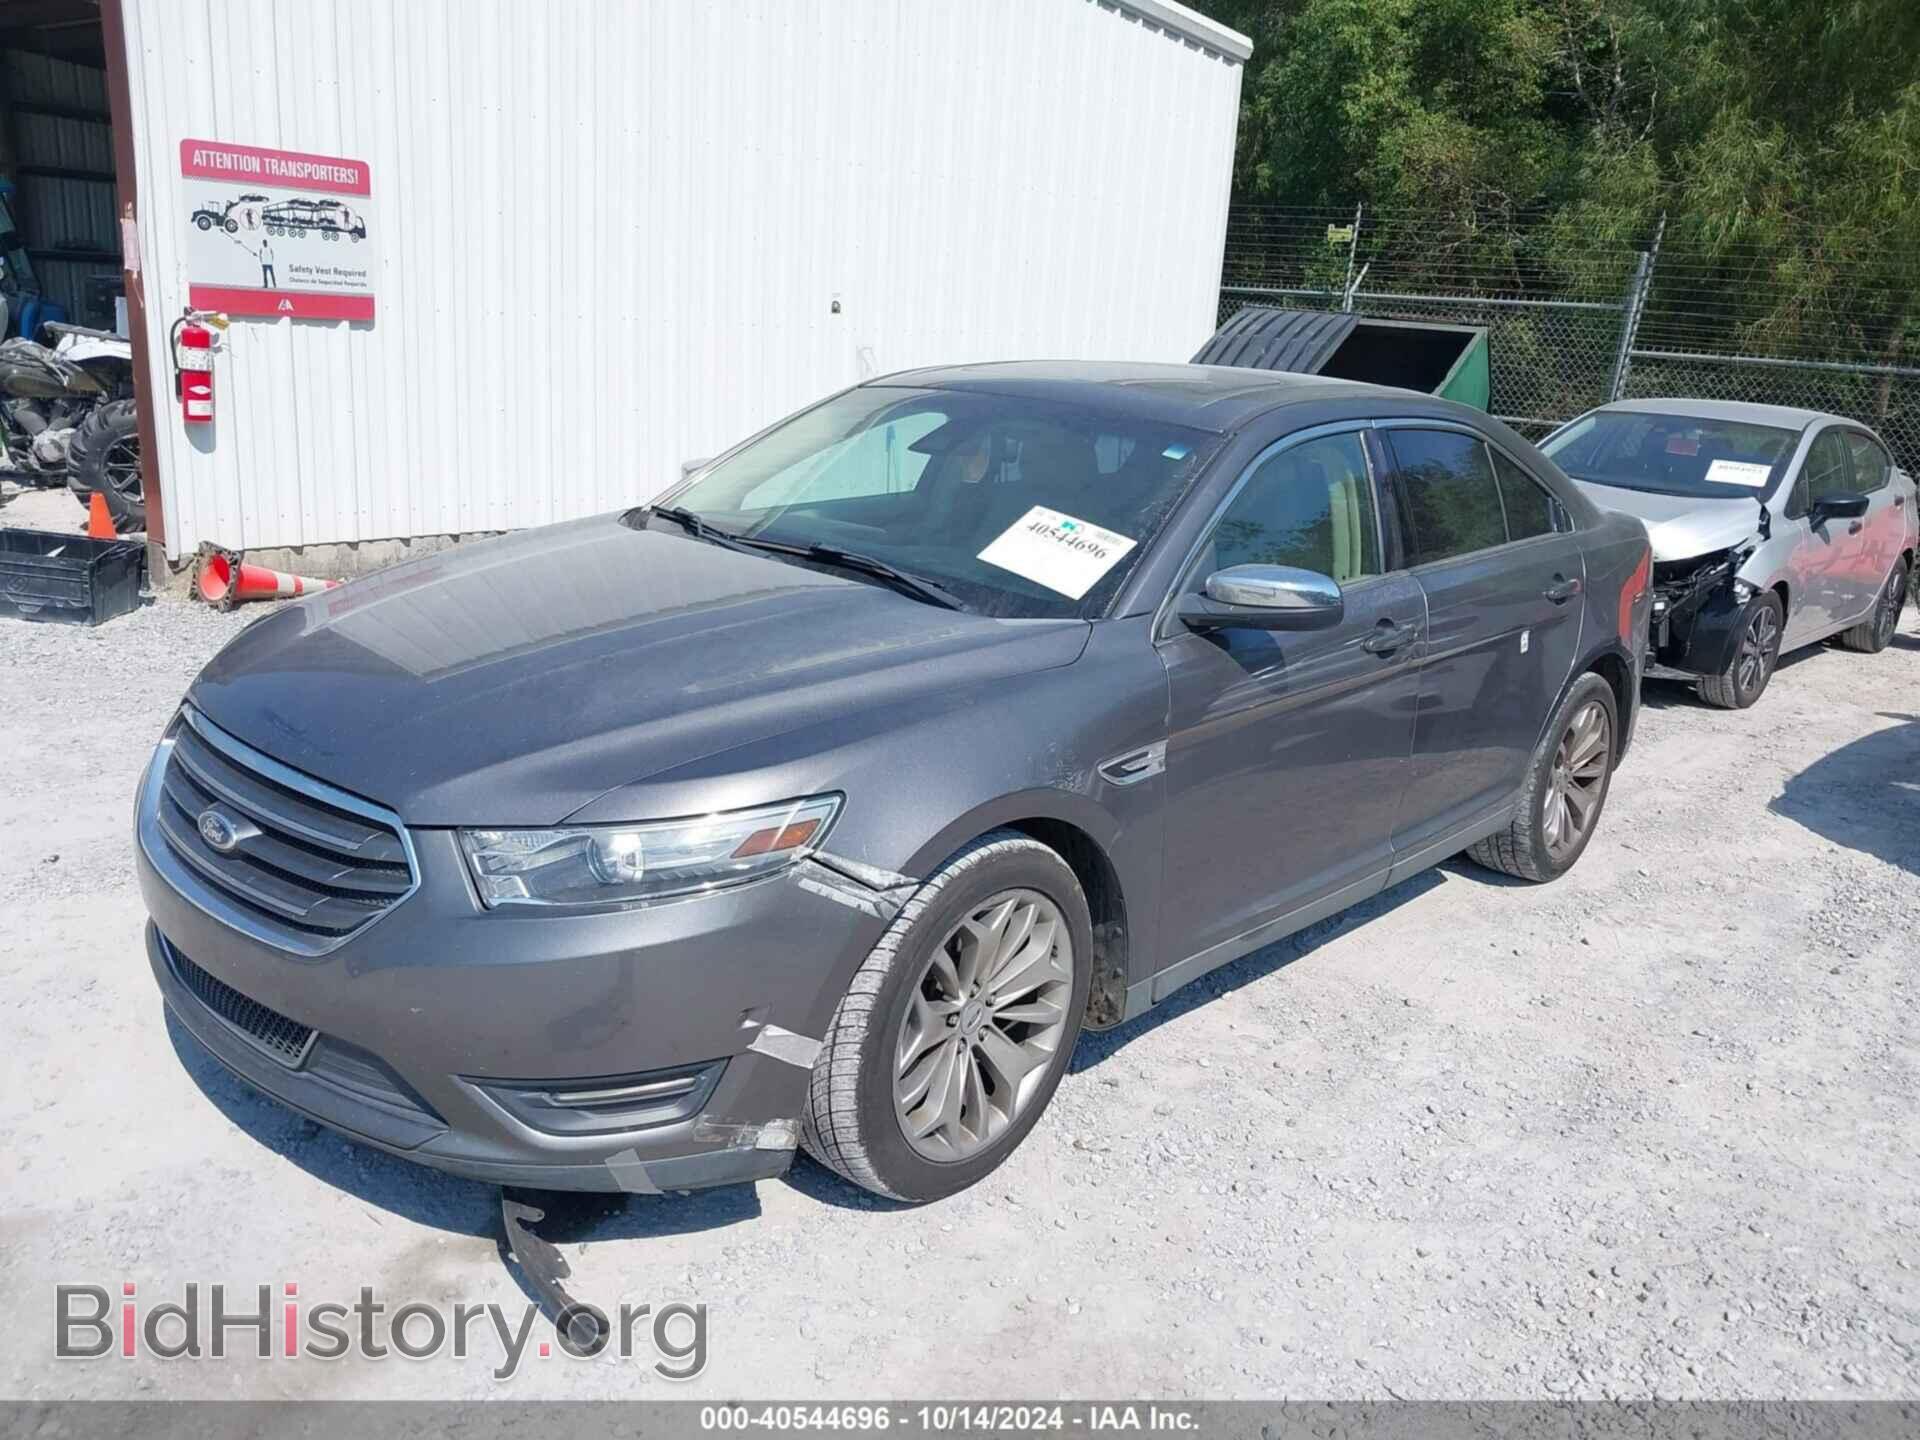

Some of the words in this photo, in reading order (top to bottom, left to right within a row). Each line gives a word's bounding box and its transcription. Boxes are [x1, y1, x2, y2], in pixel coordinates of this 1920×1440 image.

[193, 149, 260, 173] ATTENTION
[264, 158, 359, 184] TRANSPORTERS!
[289, 264, 313, 275] Safety
[315, 265, 332, 275] Vest
[333, 267, 367, 278] Required
[1027, 521, 1107, 559] 40544696
